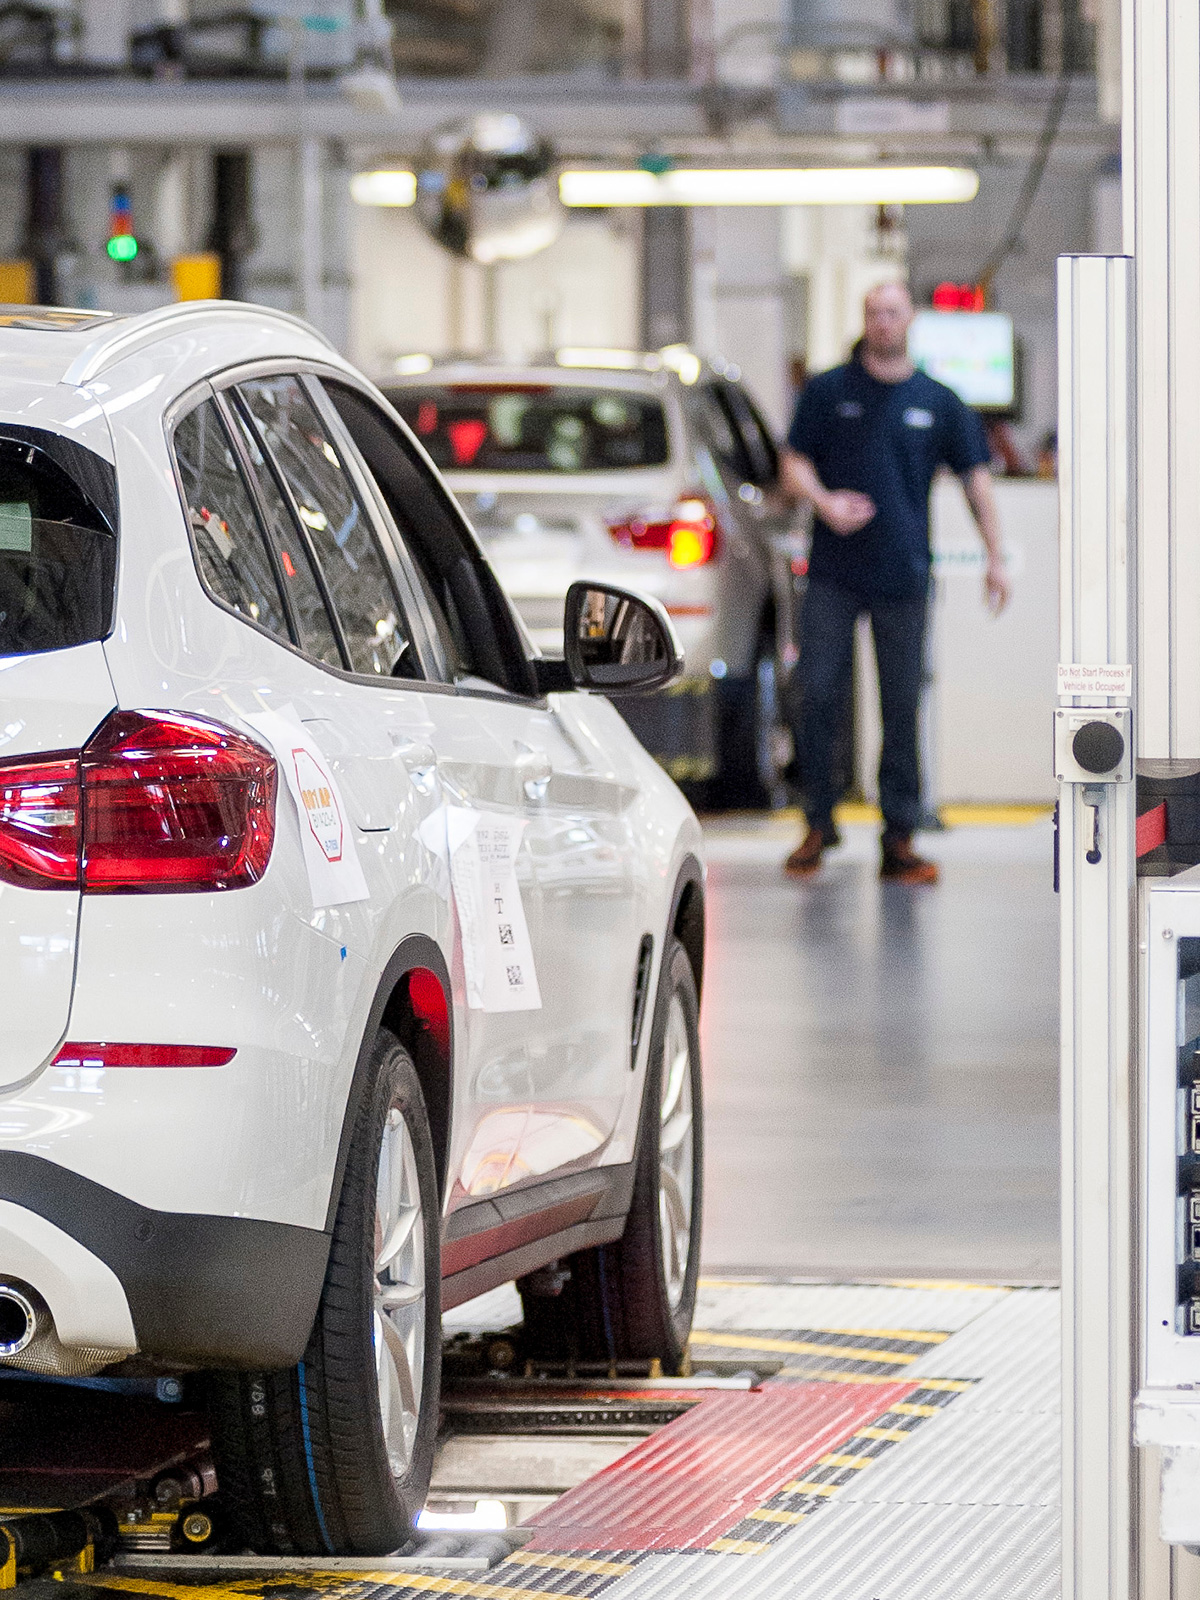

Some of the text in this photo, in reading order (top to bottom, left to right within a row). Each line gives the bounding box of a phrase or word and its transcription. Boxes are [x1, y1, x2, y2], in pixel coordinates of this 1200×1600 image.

[1058, 667, 1068, 677] Do
[1069, 667, 1081, 677] Not
[1082, 667, 1098, 677] Start
[1099, 668, 1125, 678] Process
[1063, 681, 1126, 692] Vehicle is Occupied
